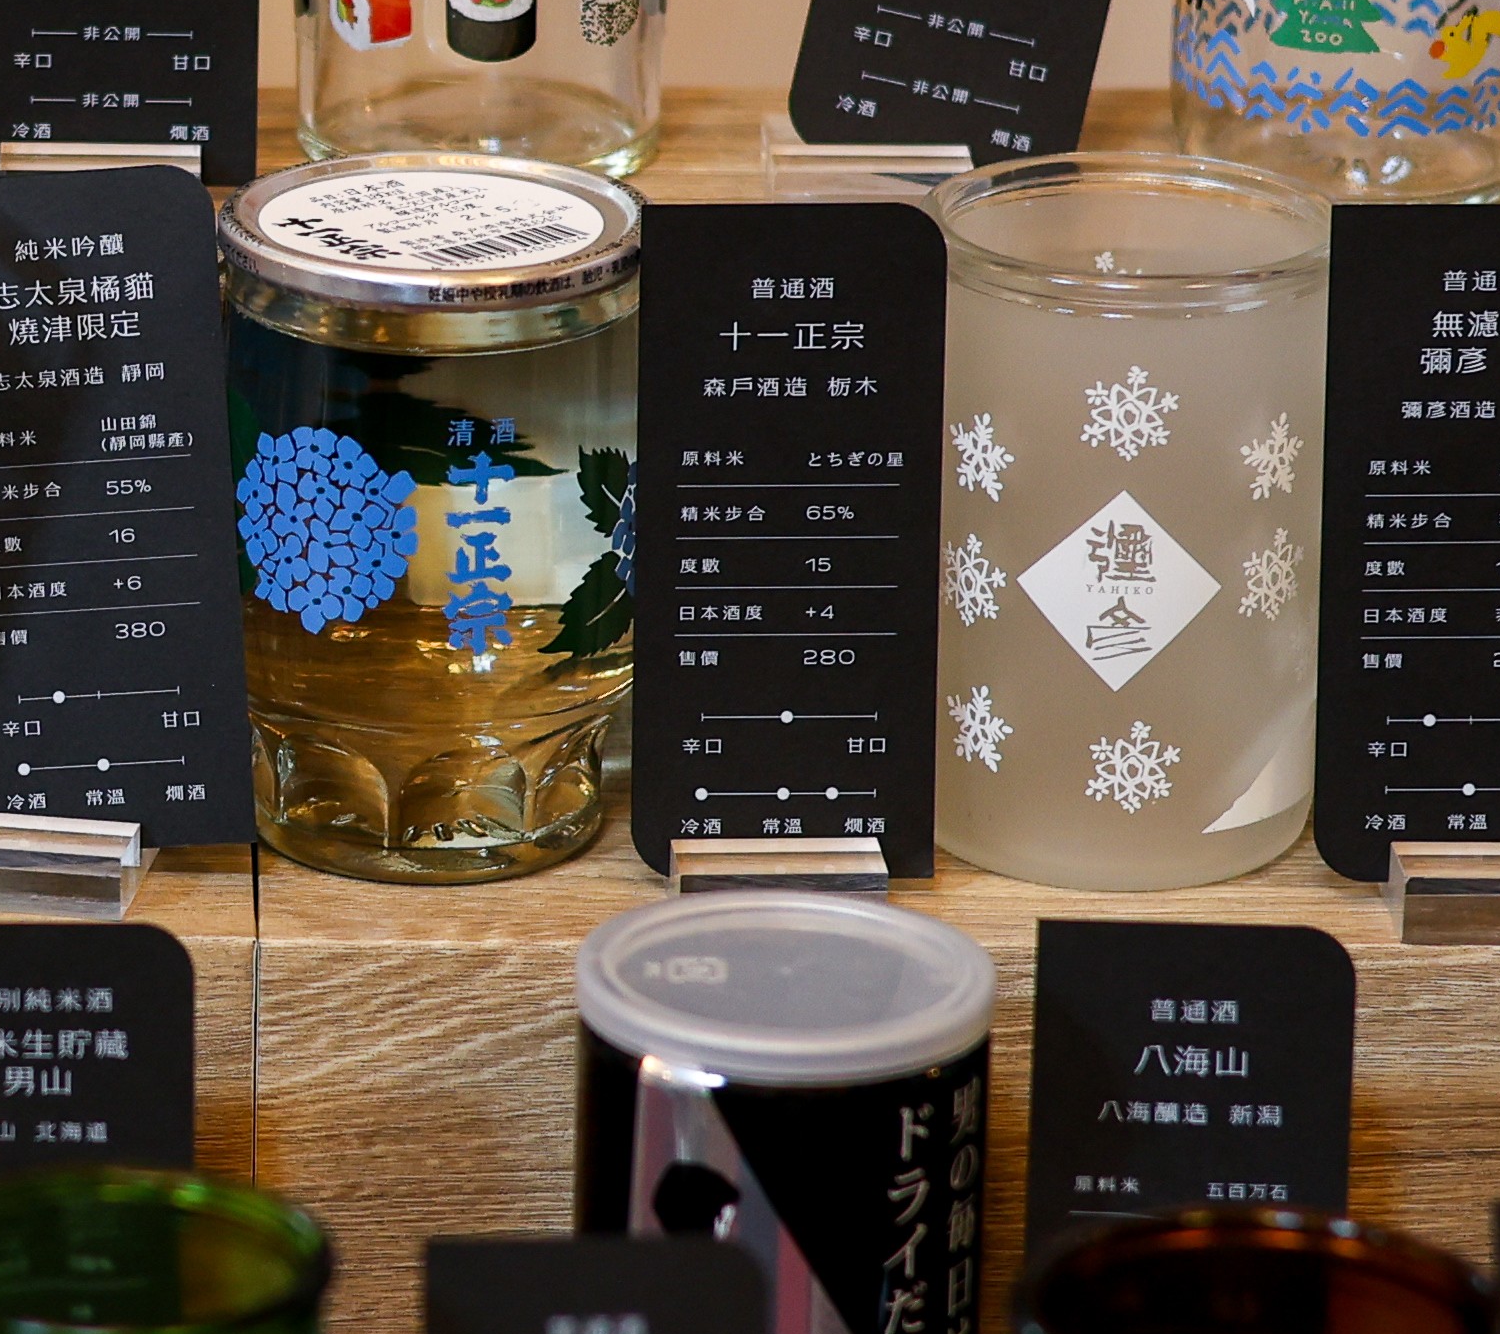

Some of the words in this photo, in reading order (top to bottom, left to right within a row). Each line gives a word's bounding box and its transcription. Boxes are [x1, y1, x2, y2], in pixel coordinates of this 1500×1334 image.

[752, 278, 834, 298] 普通酒
[9, 310, 140, 345] 燒津限定
[720, 321, 864, 350] 十一正宗
[447, 418, 516, 447] 清酒
[682, 451, 743, 466] 原料米
[107, 479, 151, 495] 55%
[807, 506, 854, 520] 65%
[442, 450, 515, 655] 十一正宗
[1086, 584, 1155, 595] YAHIKO
[680, 605, 762, 620] 日本酒度
[806, 605, 834, 619] +4
[116, 622, 165, 639] 380
[804, 650, 854, 665] 280
[1152, 999, 1237, 1023] 普通酒
[1135, 1045, 1248, 1077] 八海山
[5, 1066, 71, 1096] 男山
